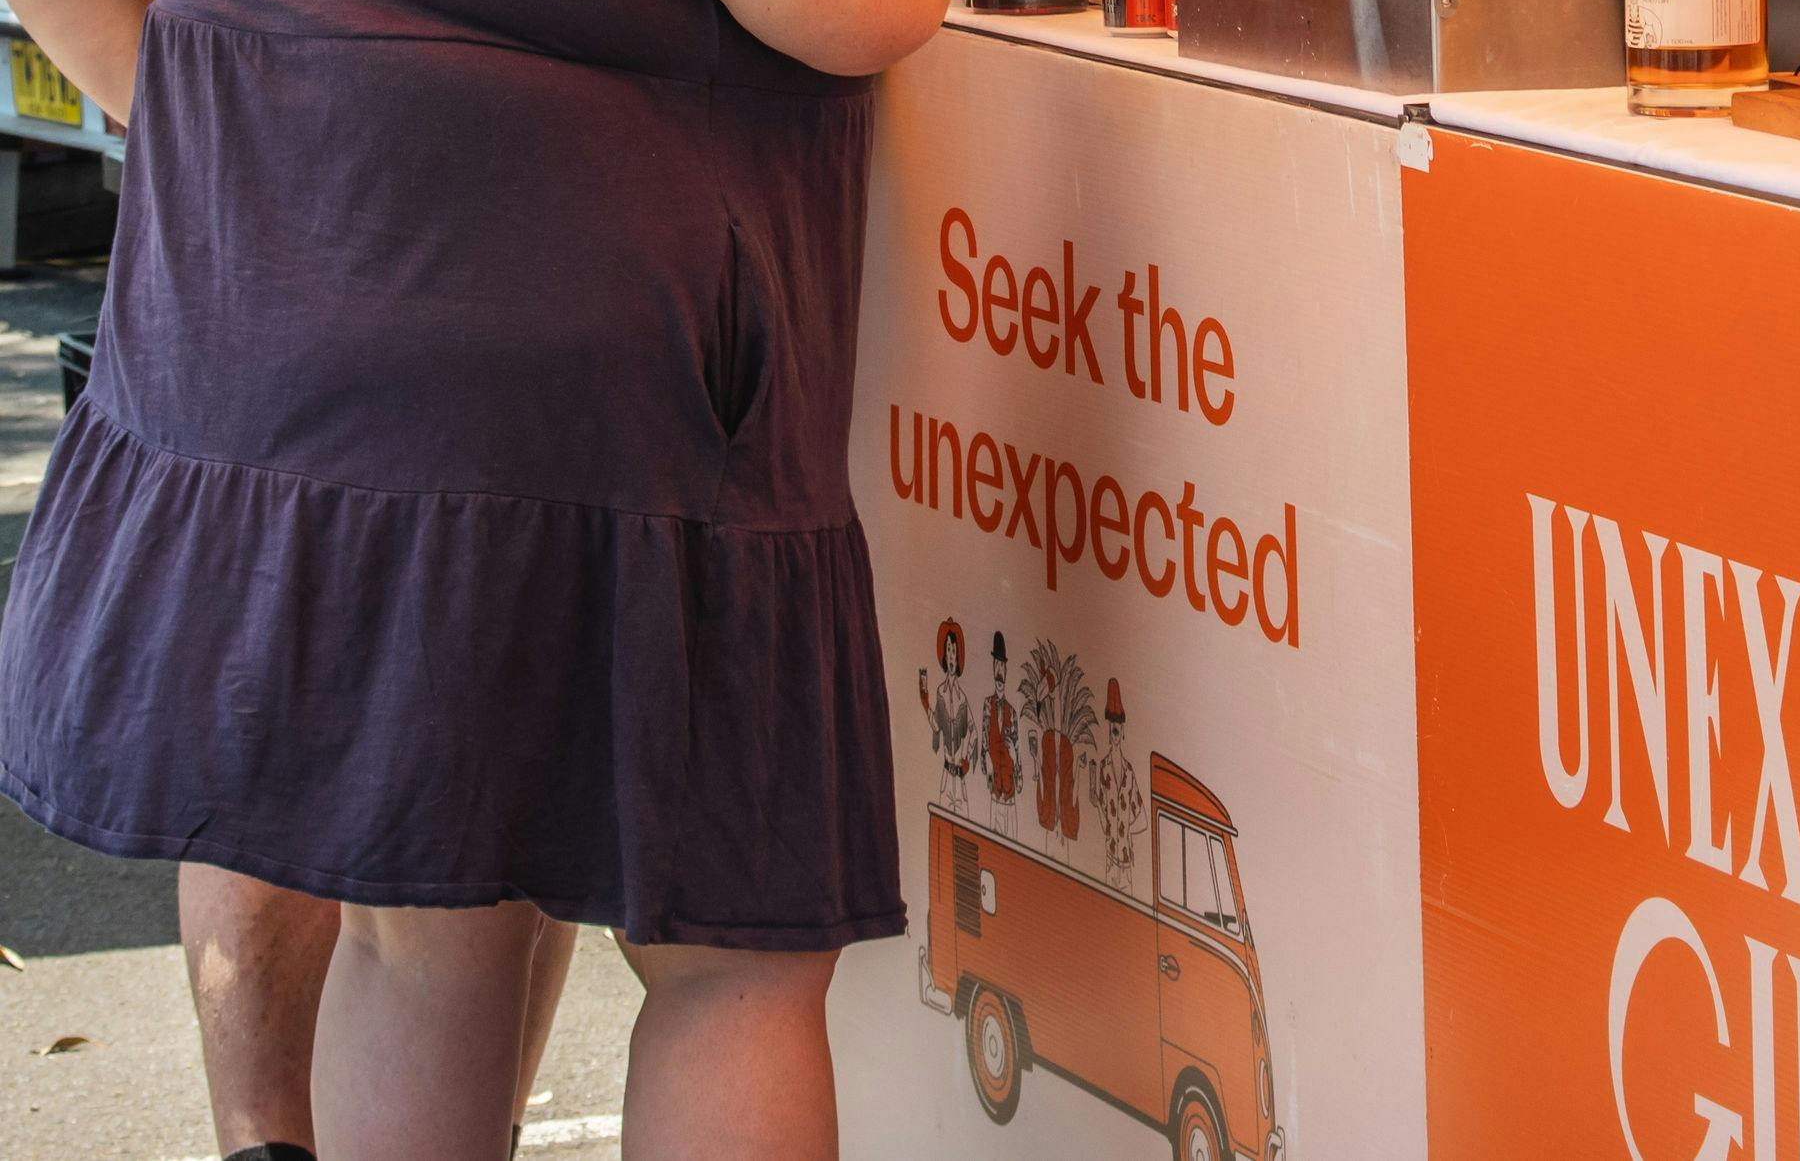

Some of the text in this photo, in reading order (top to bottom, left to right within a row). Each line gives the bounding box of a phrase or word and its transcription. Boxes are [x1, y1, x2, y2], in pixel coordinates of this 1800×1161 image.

[937, 207, 1236, 427] Seek the
[890, 404, 1300, 649] unexpected
